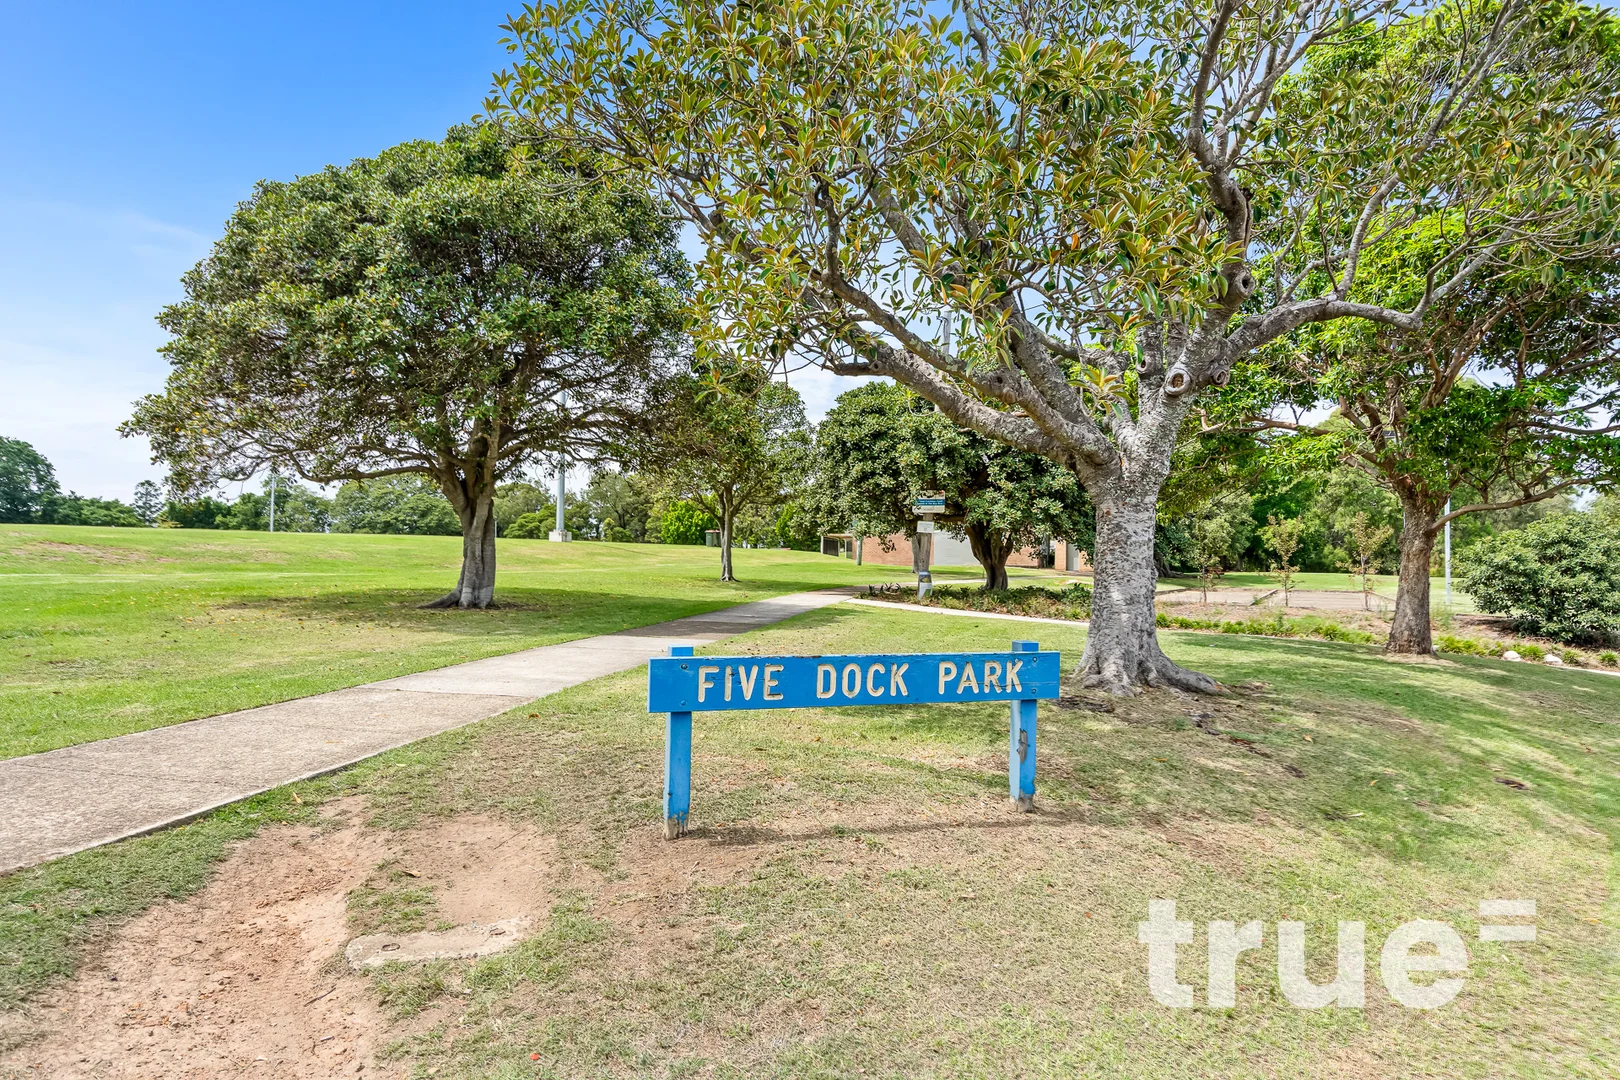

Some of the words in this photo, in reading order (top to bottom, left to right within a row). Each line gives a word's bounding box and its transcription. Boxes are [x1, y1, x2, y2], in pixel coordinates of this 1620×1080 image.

[697, 663, 785, 703] FIVE
[816, 662, 910, 699] DOCK
[938, 659, 1024, 695] PARK
